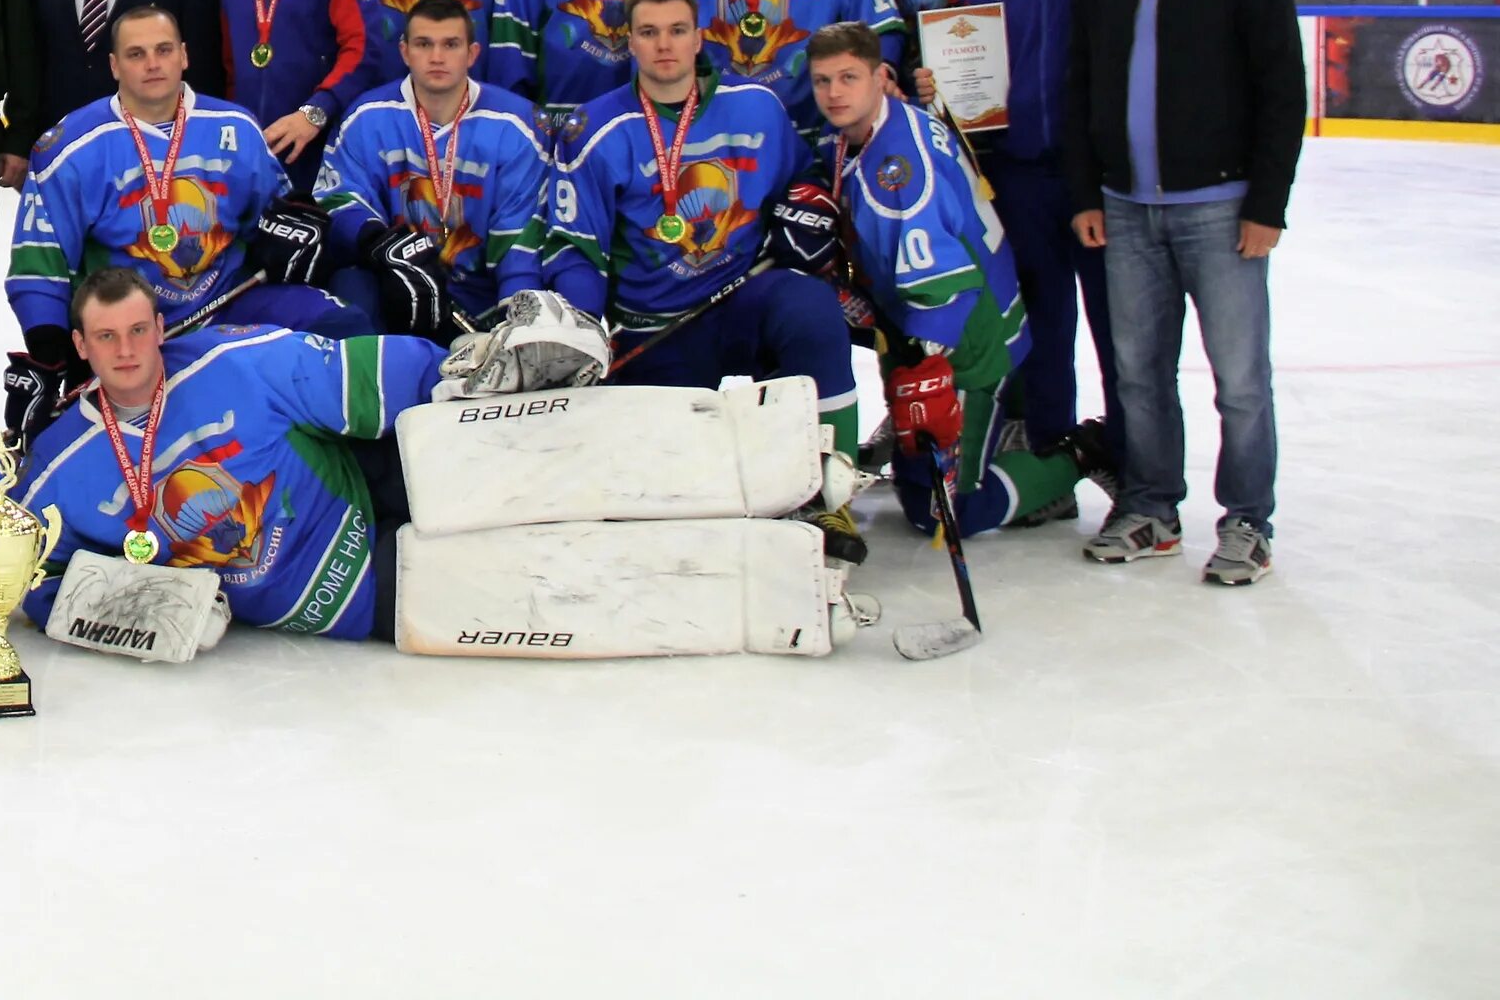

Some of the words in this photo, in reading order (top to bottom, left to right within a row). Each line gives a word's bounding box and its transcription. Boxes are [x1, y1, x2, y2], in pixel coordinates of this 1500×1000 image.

[605, 52, 631, 64] РОСС
[942, 45, 987, 57] ГРАМОТА
[154, 284, 178, 301] ВДВ
[458, 397, 570, 425] BAUER
[223, 573, 249, 585] ВДВ
[251, 526, 284, 580] РОССИИ
[305, 558, 351, 625] КРОМЕ
[69, 616, 156, 652] VAUGHN
[457, 629, 573, 648] BAUER
